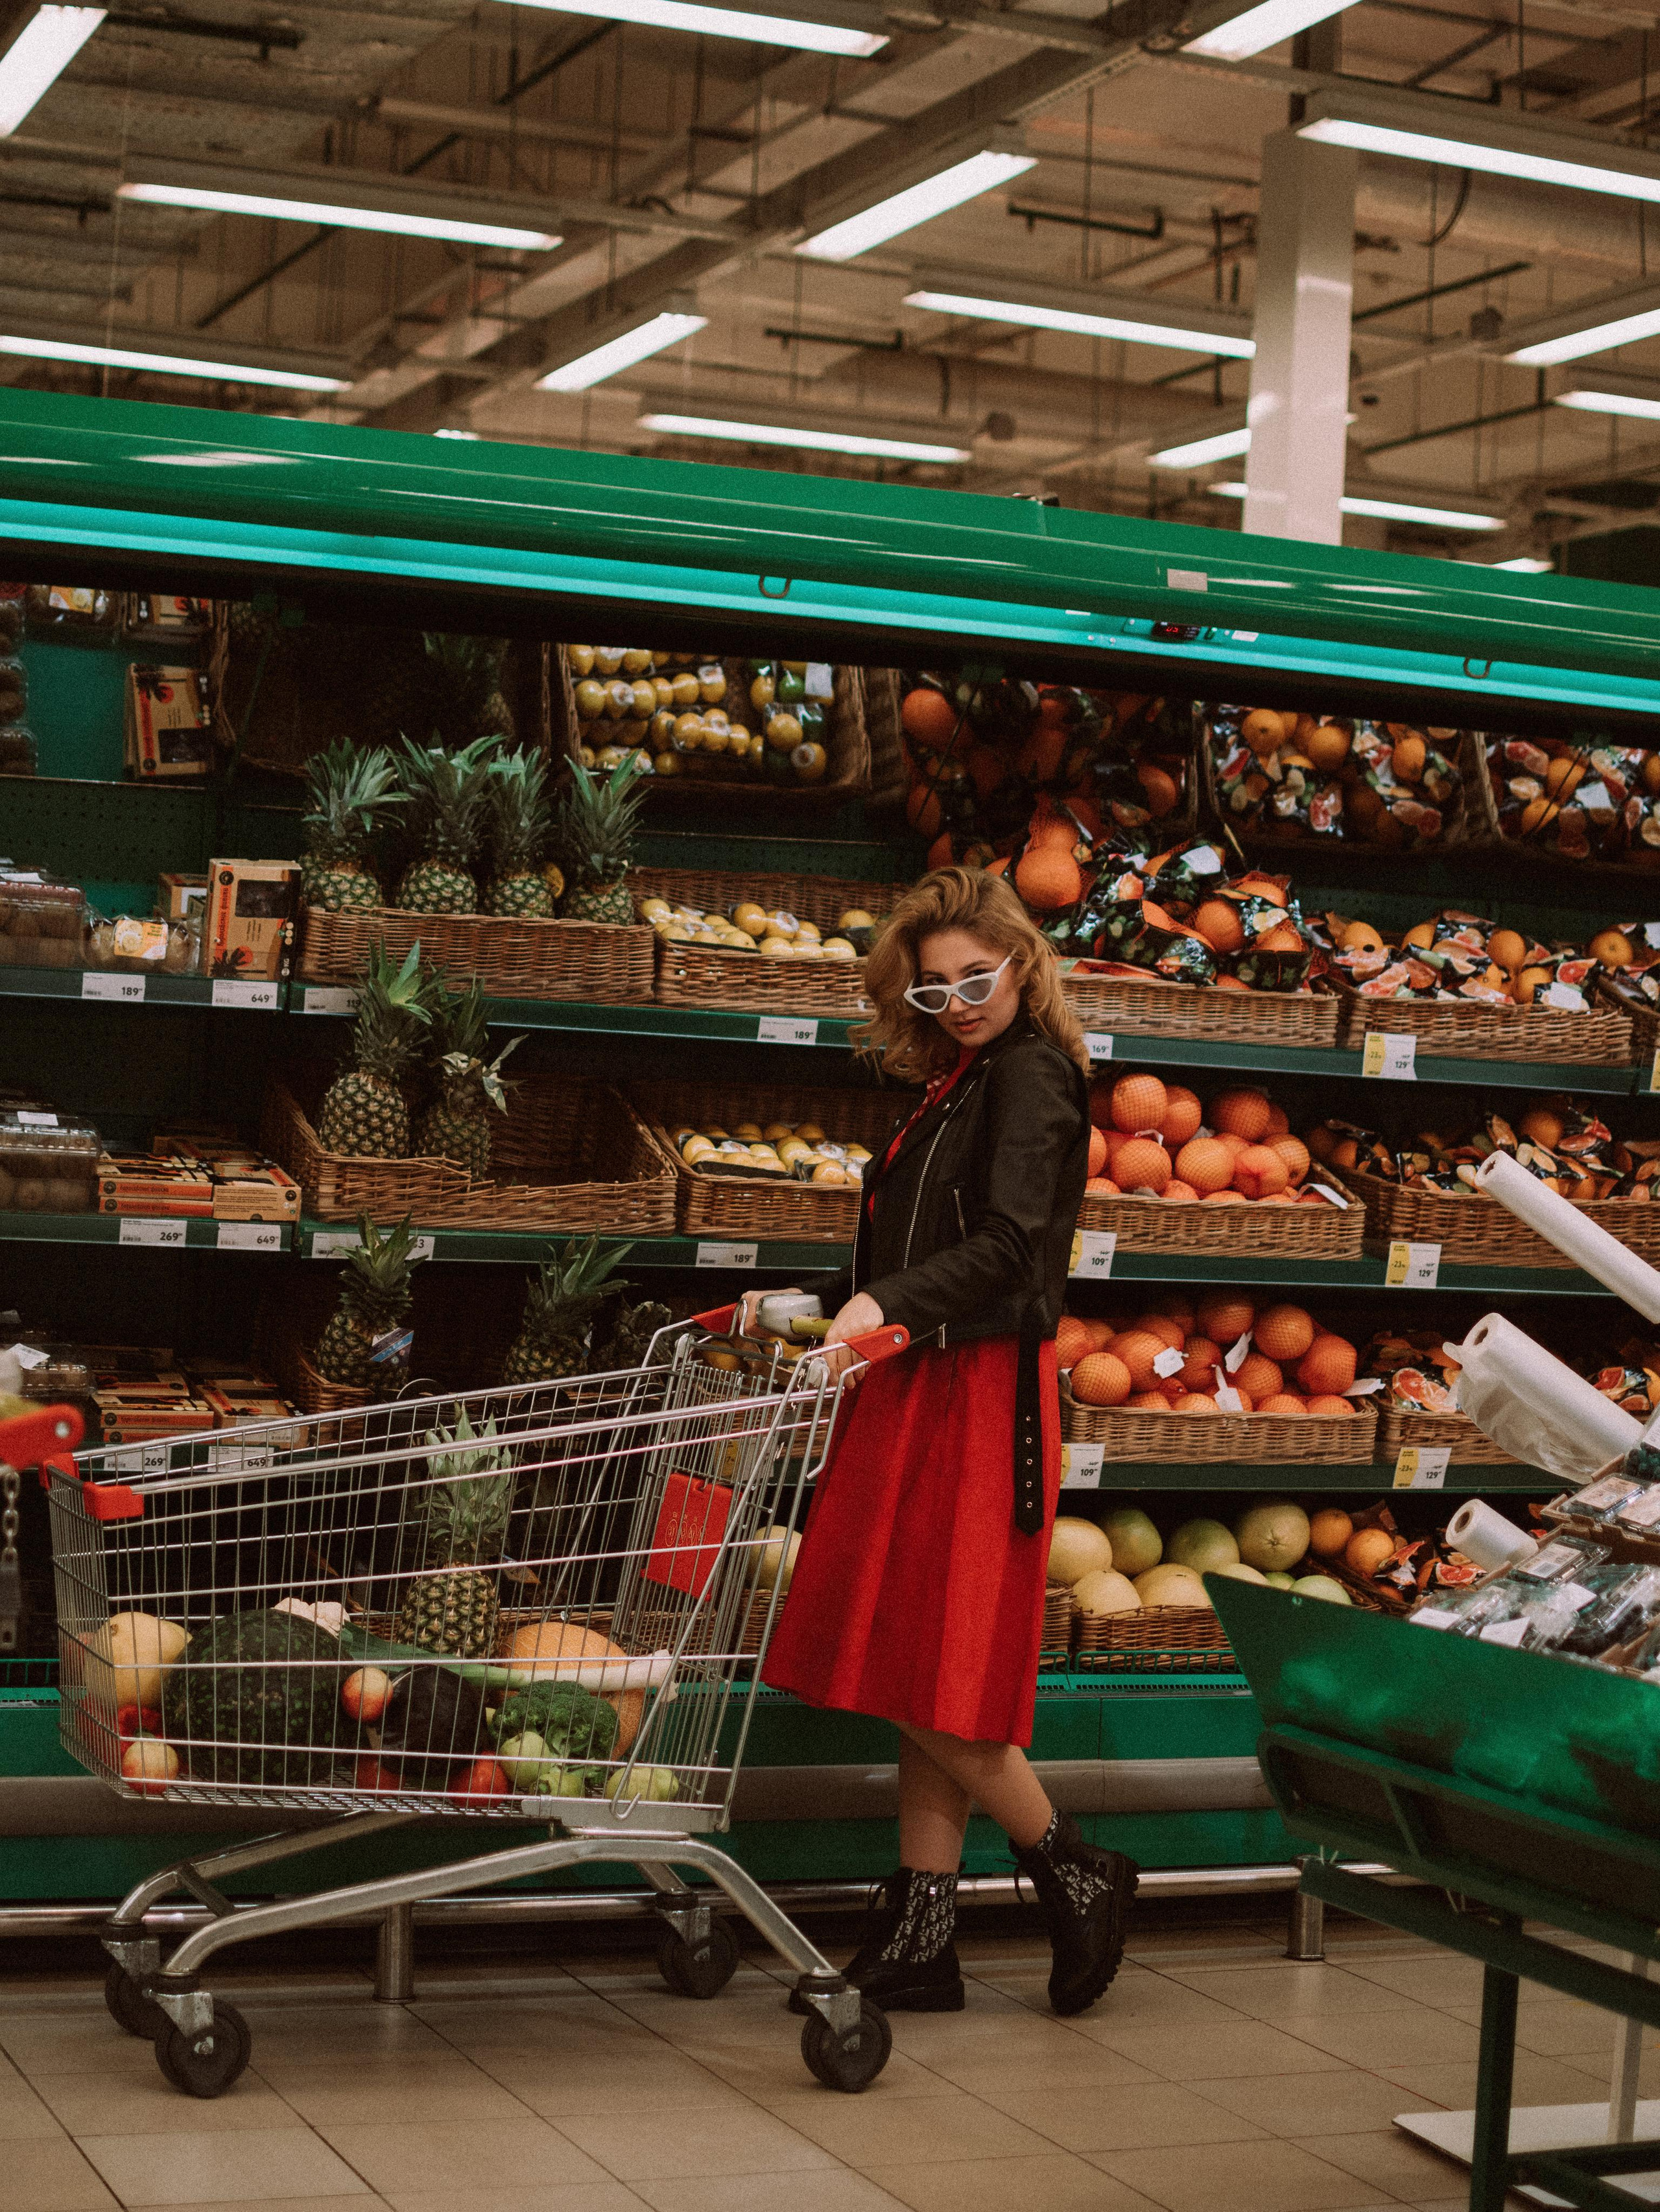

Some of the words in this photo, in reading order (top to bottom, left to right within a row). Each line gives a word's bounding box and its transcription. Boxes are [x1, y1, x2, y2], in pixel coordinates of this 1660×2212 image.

[160, 1232, 179, 1241] 269
[257, 1236, 276, 1244] 649
[1091, 1257, 1105, 1265] 109
[145, 1457, 163, 1466] 269
[1080, 1468, 1095, 1477] 109
